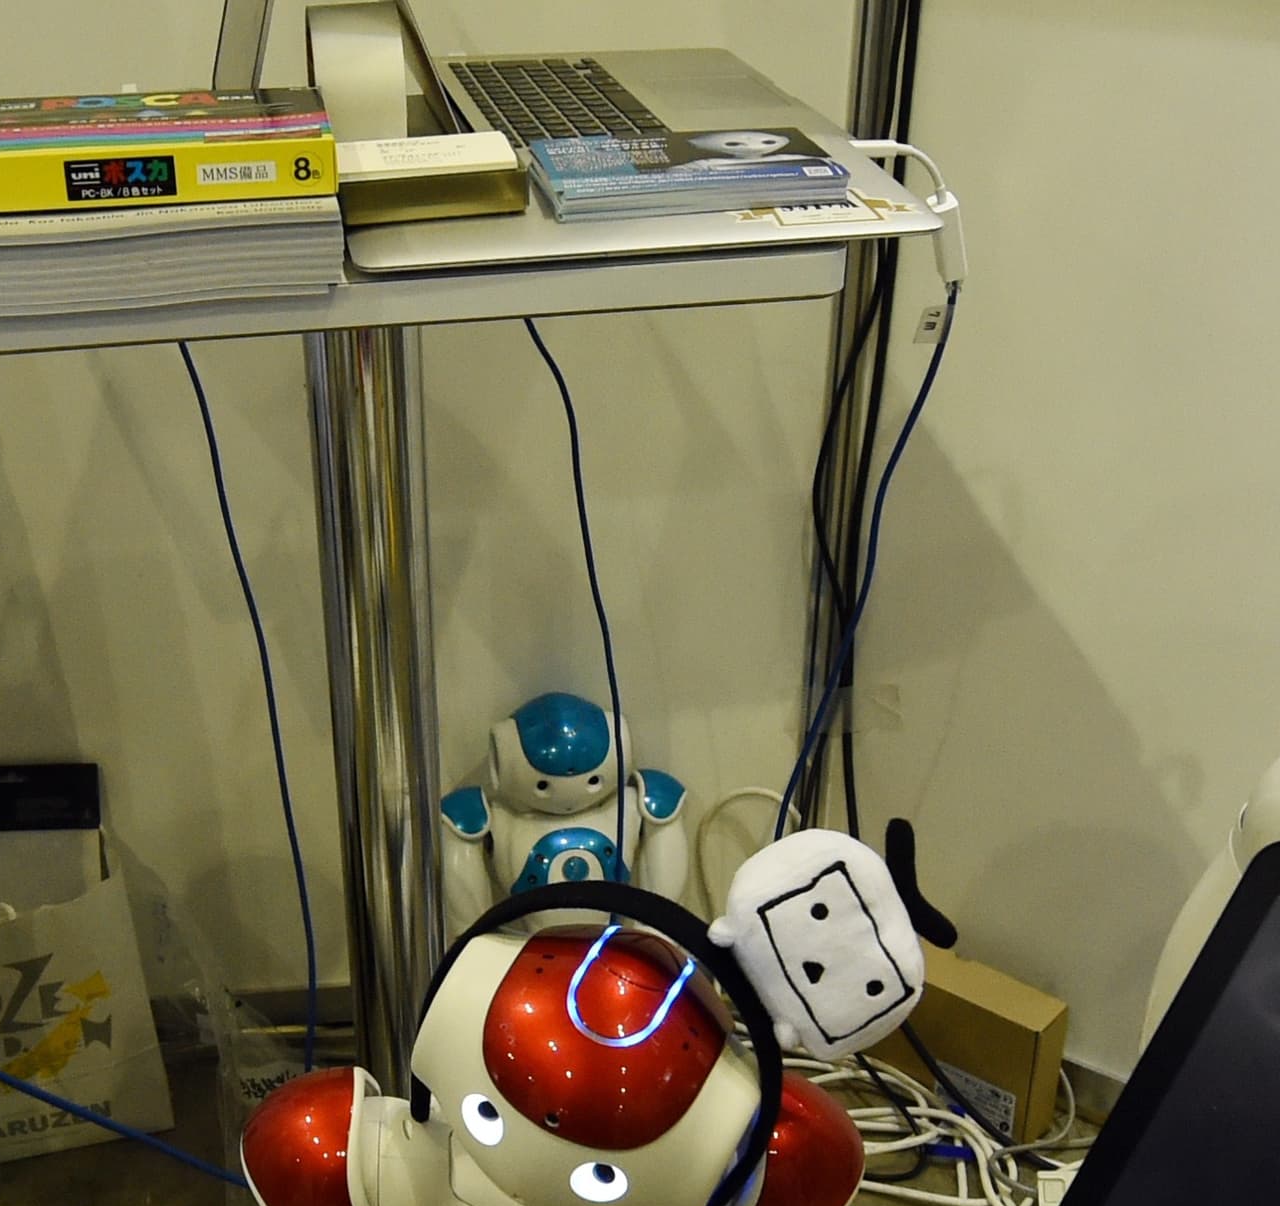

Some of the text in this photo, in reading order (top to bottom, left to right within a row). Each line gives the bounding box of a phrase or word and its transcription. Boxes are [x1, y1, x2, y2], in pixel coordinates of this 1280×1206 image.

[40, 92, 218, 111] POSCA
[71, 167, 100, 181] uni
[104, 159, 168, 185] ポスカ
[201, 164, 269, 182] MMS備品
